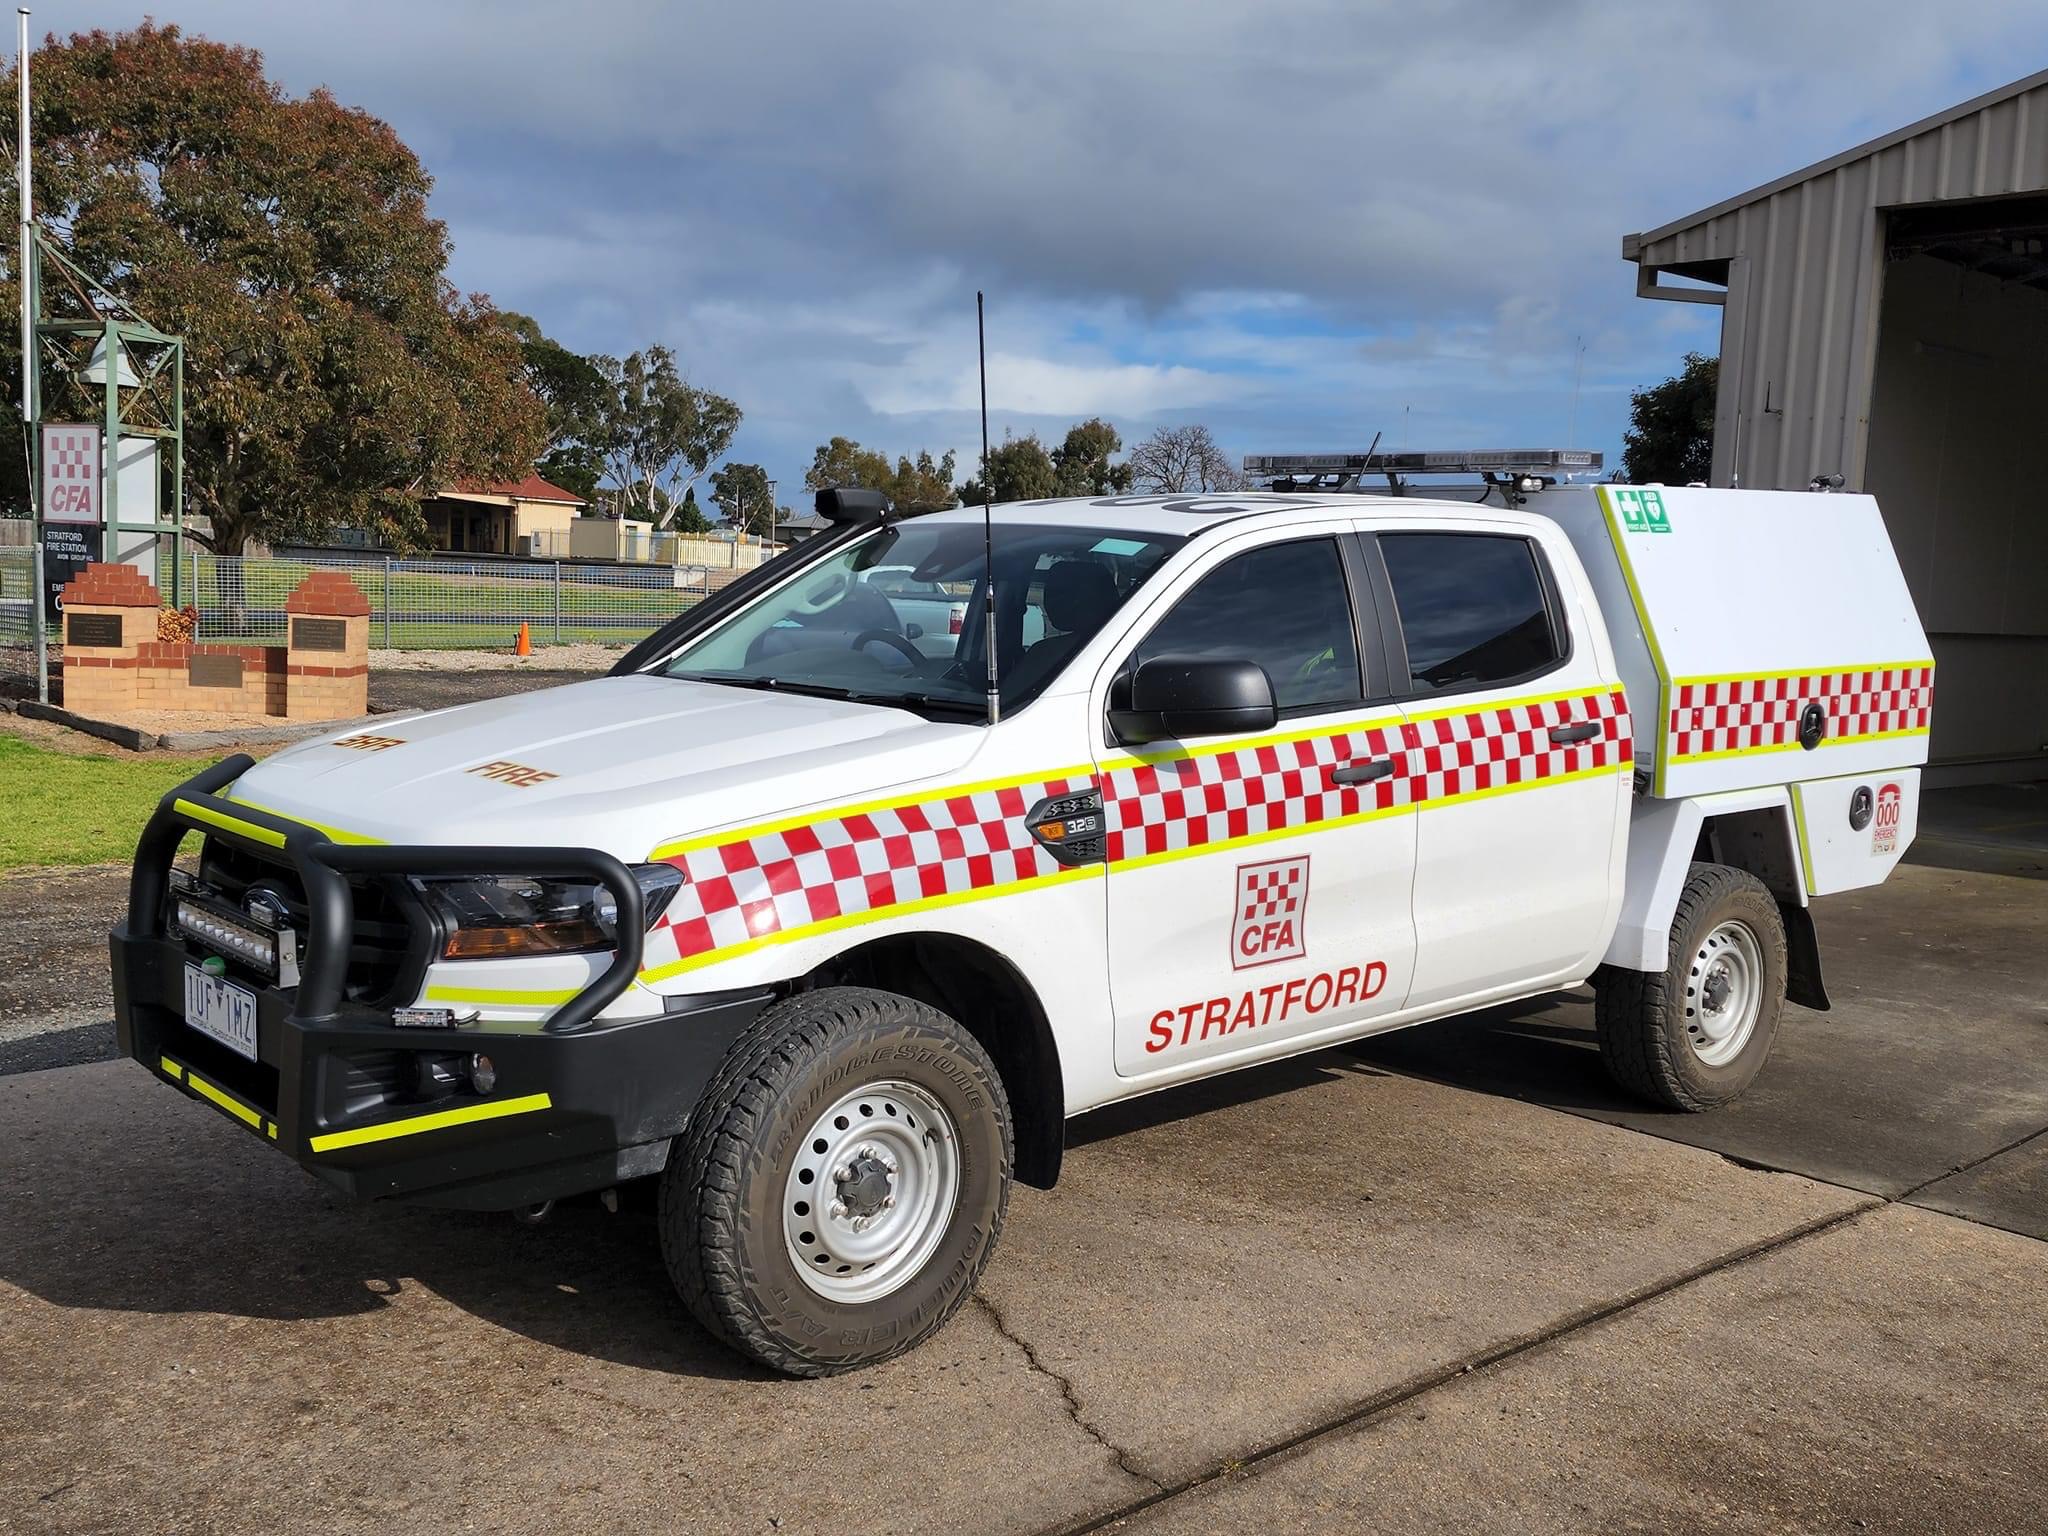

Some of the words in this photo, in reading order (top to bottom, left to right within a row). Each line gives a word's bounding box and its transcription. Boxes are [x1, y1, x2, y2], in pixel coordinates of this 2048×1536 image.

[50, 484, 91, 513] CFA
[46, 531, 83, 542] STRATFORD
[46, 542, 61, 551] FIRE
[61, 543, 87, 553] STATION
[463, 760, 561, 788] FIRE
[1876, 802, 1899, 827] 000
[1239, 919, 1296, 957] CFA
[188, 974, 212, 1021] 1UF
[1144, 960, 1388, 1053] STRATFORD
[771, 1043, 986, 1171] BRIDGESTONE
[840, 1223, 982, 1347] DUELER
[769, 1288, 831, 1338] A/T
